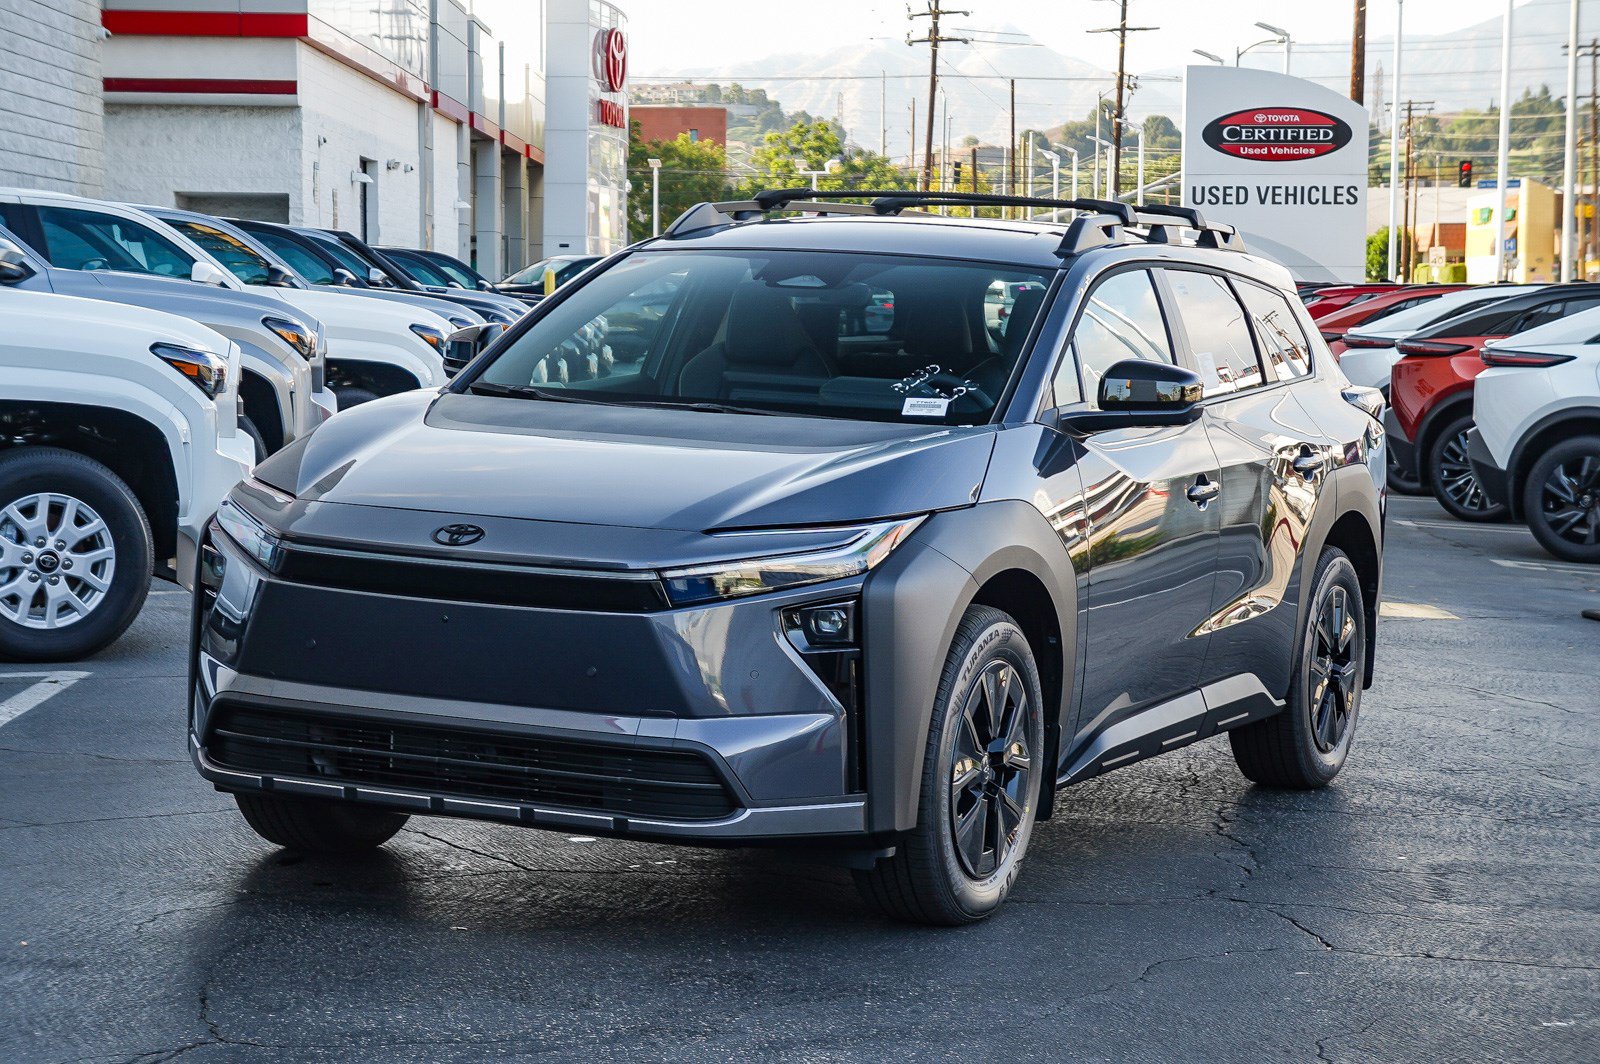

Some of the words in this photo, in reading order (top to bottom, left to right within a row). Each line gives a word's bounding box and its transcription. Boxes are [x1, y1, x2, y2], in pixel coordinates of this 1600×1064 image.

[1267, 114, 1300, 122] TOYOTA
[1222, 125, 1334, 141] CERTIFIED
[1240, 146, 1268, 155] Used
[1271, 146, 1316, 155] Vehicles
[1191, 185, 1249, 206] USED
[1256, 185, 1358, 206] VEHICLES
[962, 629, 1001, 682] TURANZA
